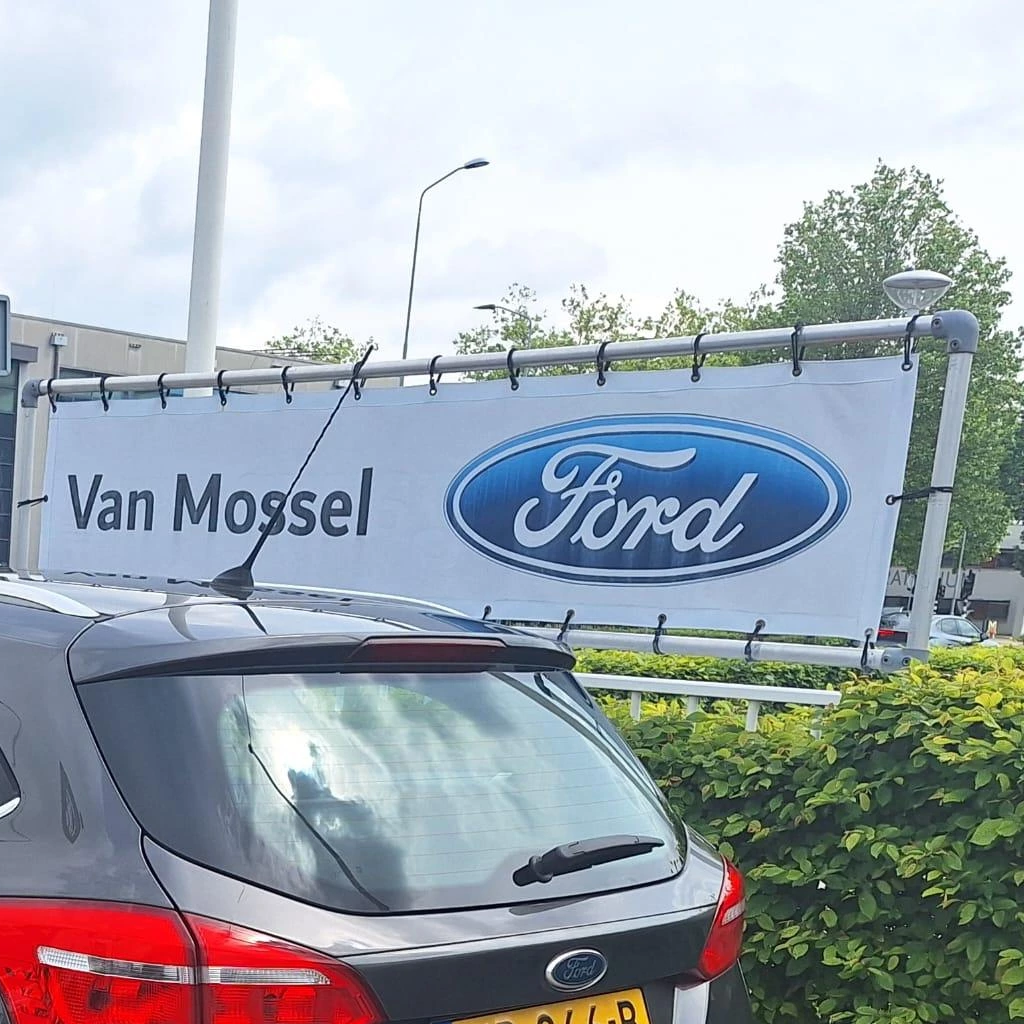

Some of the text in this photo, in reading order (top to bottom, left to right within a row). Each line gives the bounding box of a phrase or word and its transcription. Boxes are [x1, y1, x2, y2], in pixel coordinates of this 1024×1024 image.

[68, 467, 373, 537] Van Mossel
[513, 443, 759, 553] Ford
[563, 955, 597, 981] Ford
